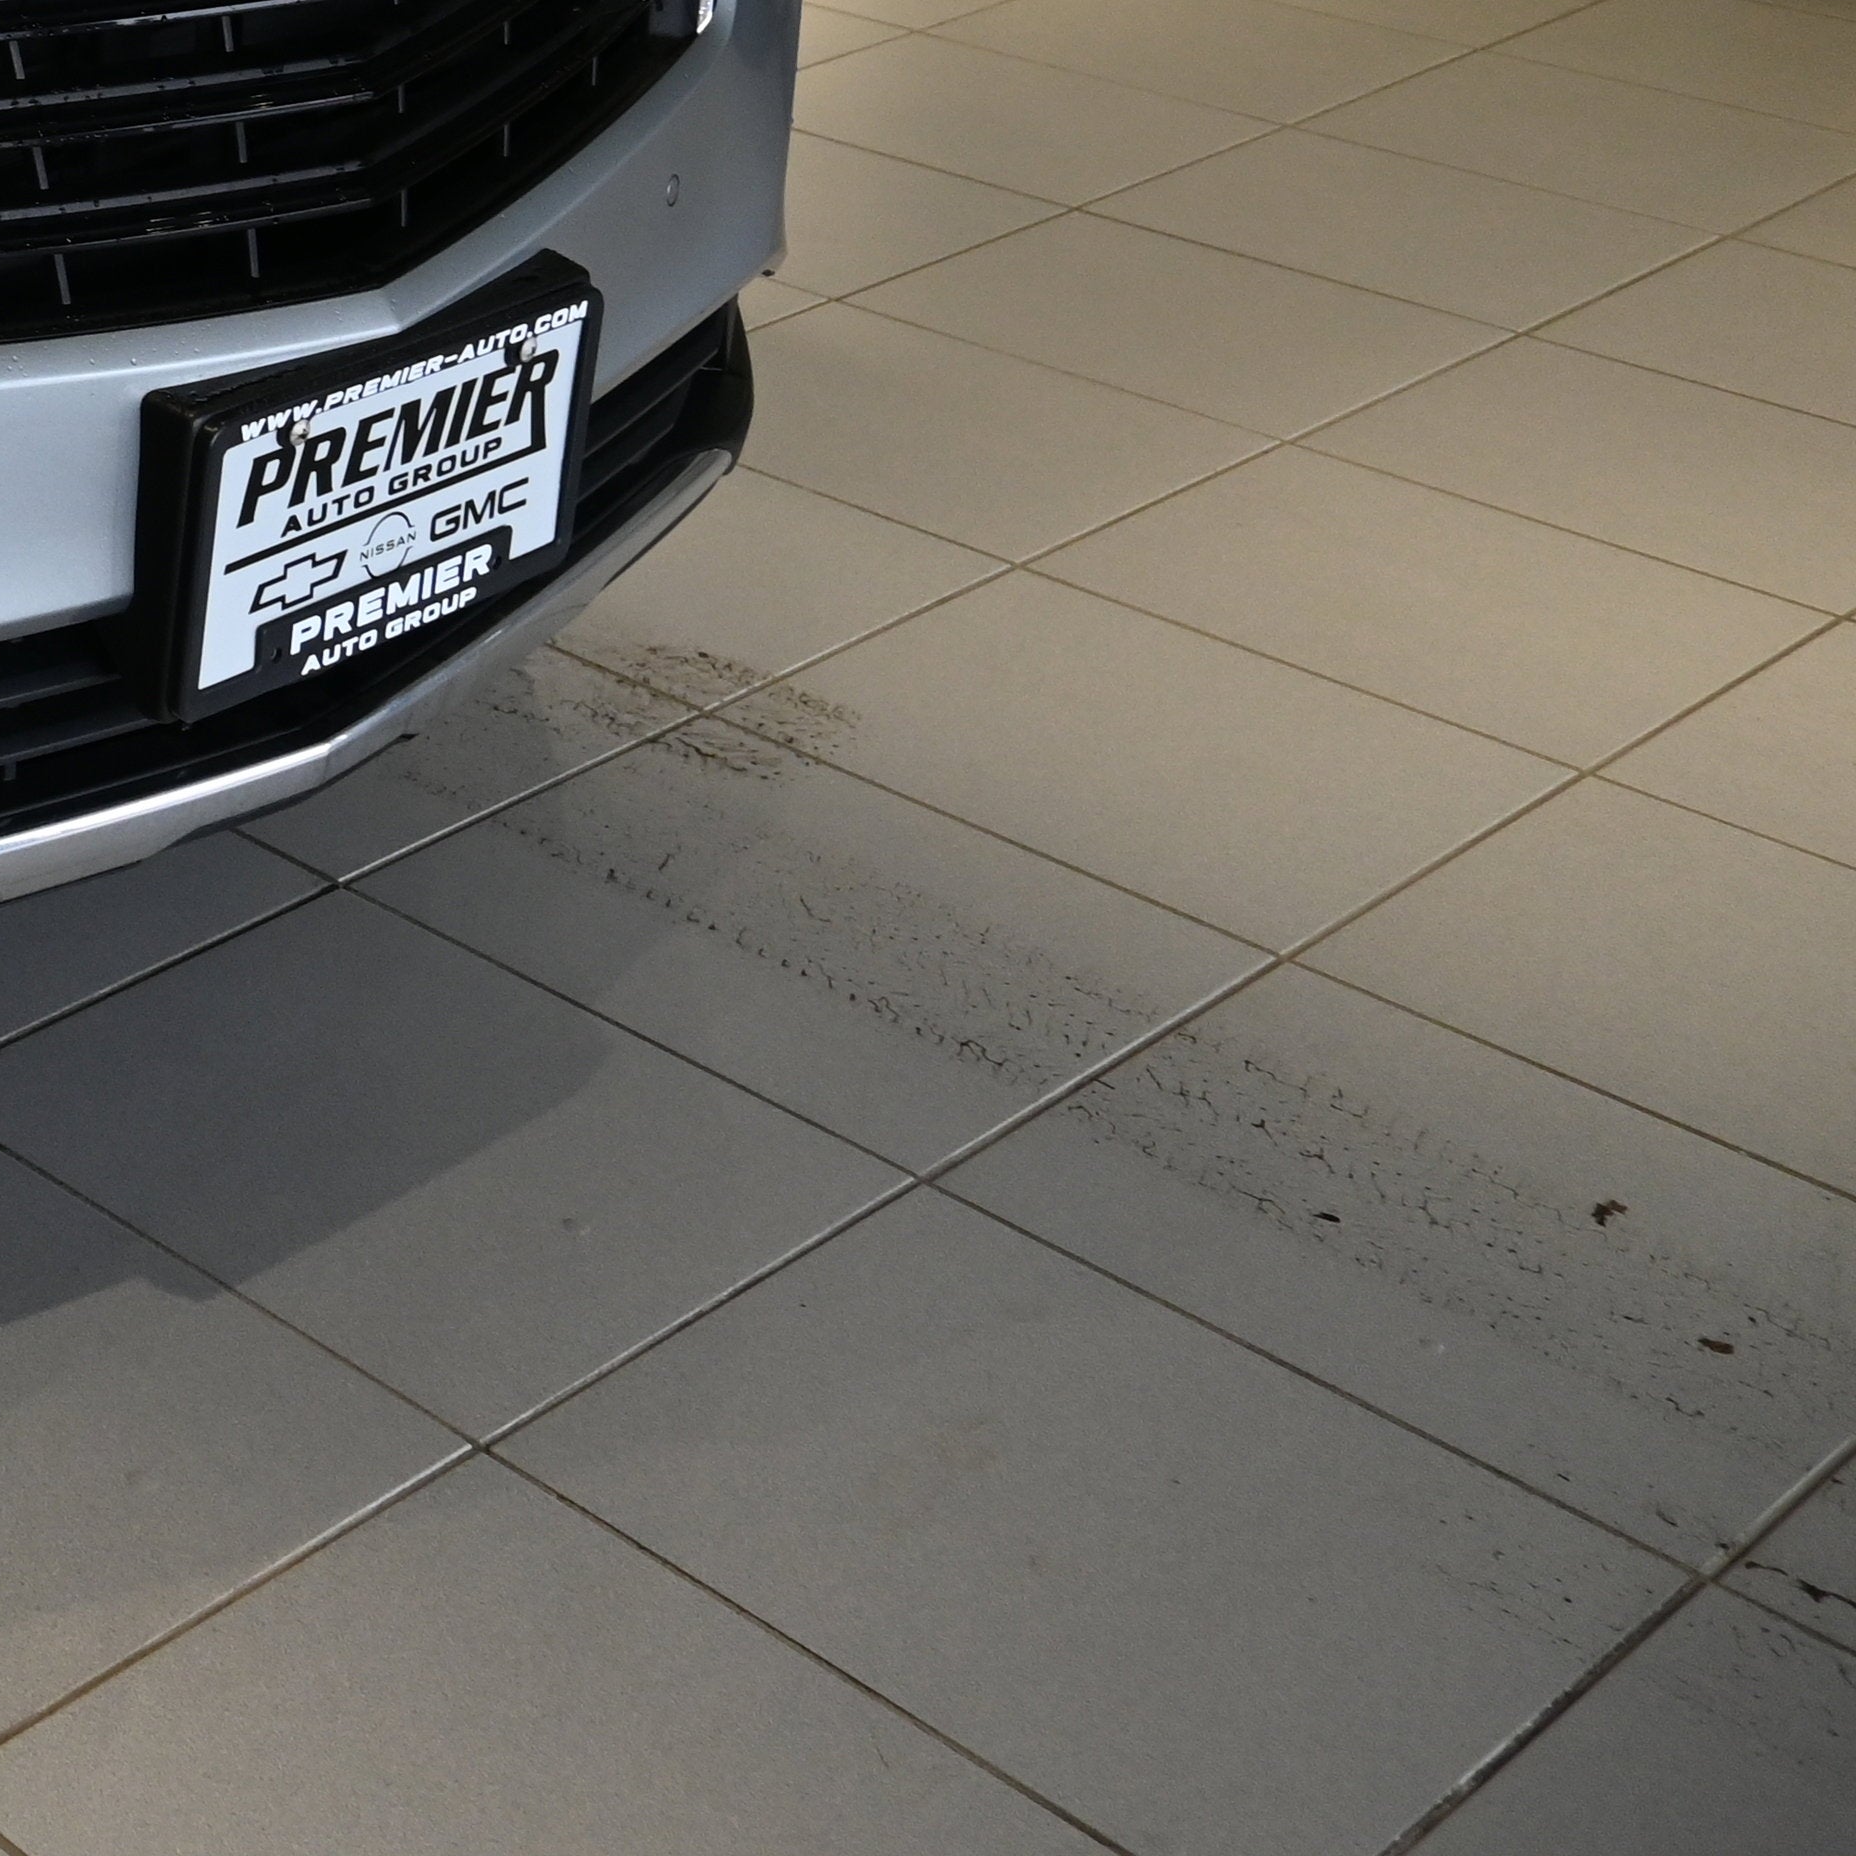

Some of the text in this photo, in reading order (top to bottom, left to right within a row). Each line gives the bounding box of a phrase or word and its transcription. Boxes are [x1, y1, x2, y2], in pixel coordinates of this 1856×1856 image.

[236, 349, 560, 529] PREMIER
[280, 437, 502, 538] AUTO GROUP
[360, 477, 529, 562] NISSAN GMC
[290, 544, 494, 656] PREMIER
[301, 587, 478, 676] AUTO GROUP
